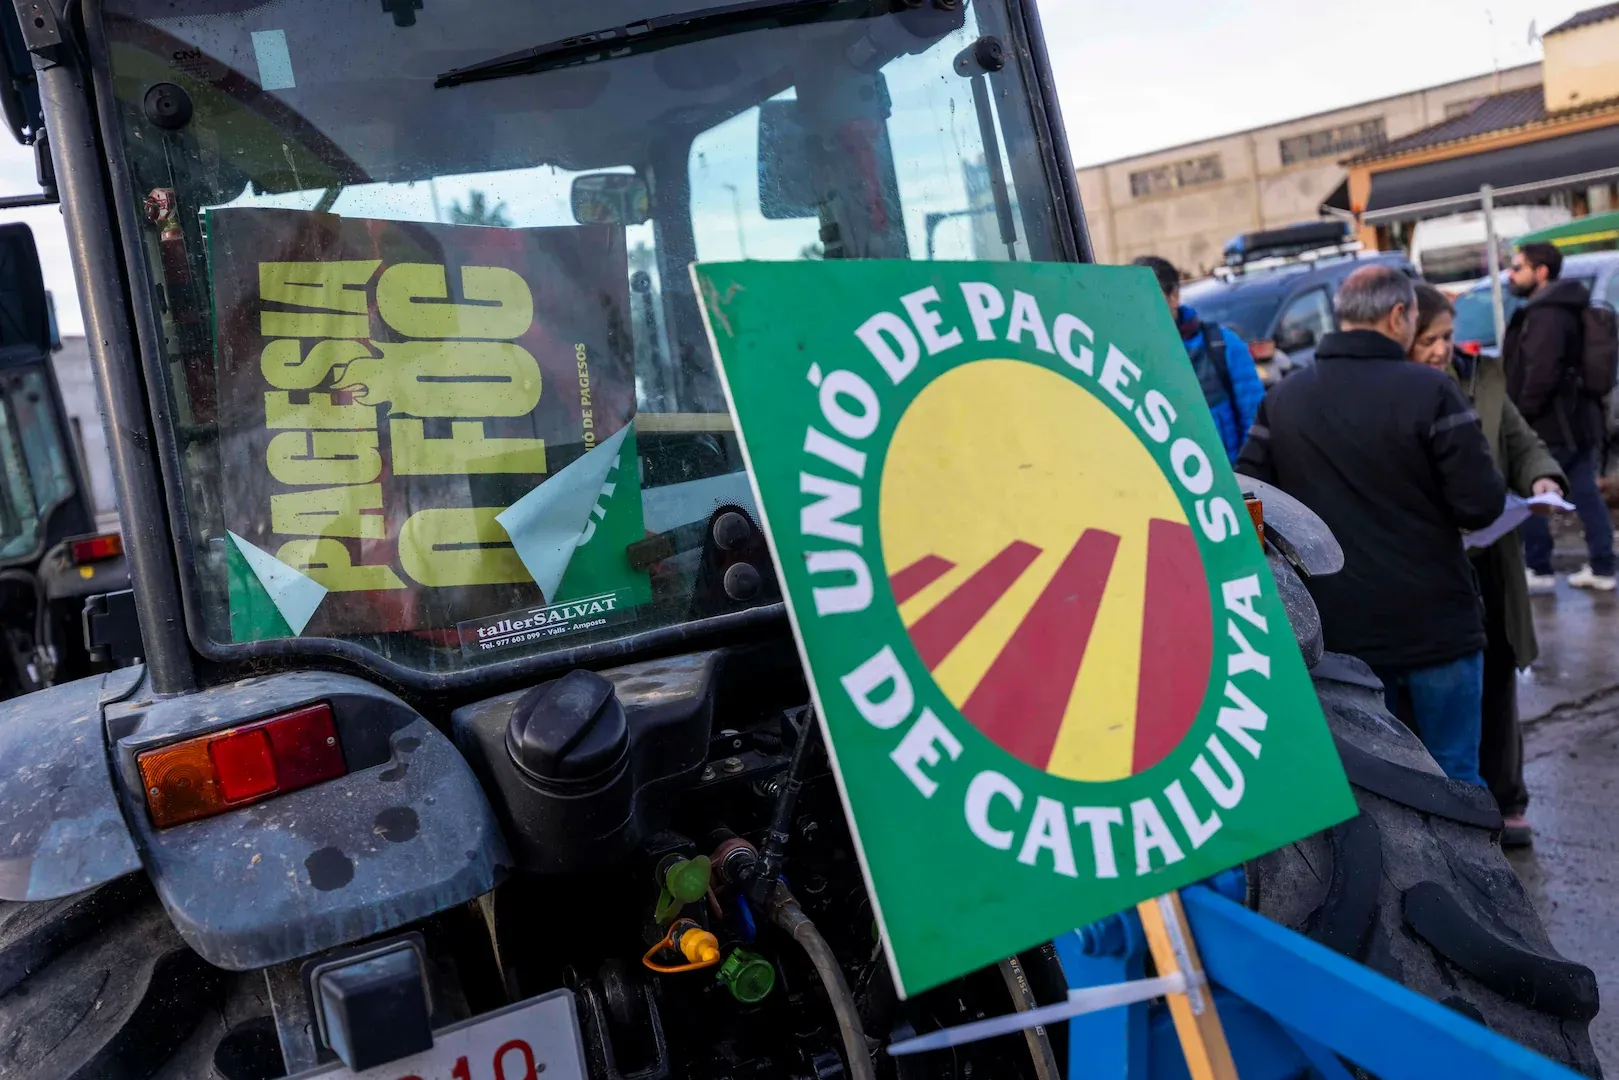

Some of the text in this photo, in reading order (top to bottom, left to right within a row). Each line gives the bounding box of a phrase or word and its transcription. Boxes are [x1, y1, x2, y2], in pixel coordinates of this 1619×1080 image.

[375, 262, 547, 475] FOC
[575, 343, 591, 406] PAGESOS
[259, 259, 408, 592] PAGESIA
[582, 409, 594, 428] DE
[801, 282, 1240, 615] UNIÓ DE PAGESOS
[477, 597, 617, 638] tallerSALVAT
[480, 641, 495, 650] Tel.
[496, 639, 509, 647] 977
[511, 635, 525, 644] 603
[527, 631, 540, 640] 099
[548, 626, 566, 636] Valls
[573, 617, 606, 631] Amposta
[843, 574, 1270, 877] DE CATALUNYA
[1017, 976, 1029, 994] 2SN
